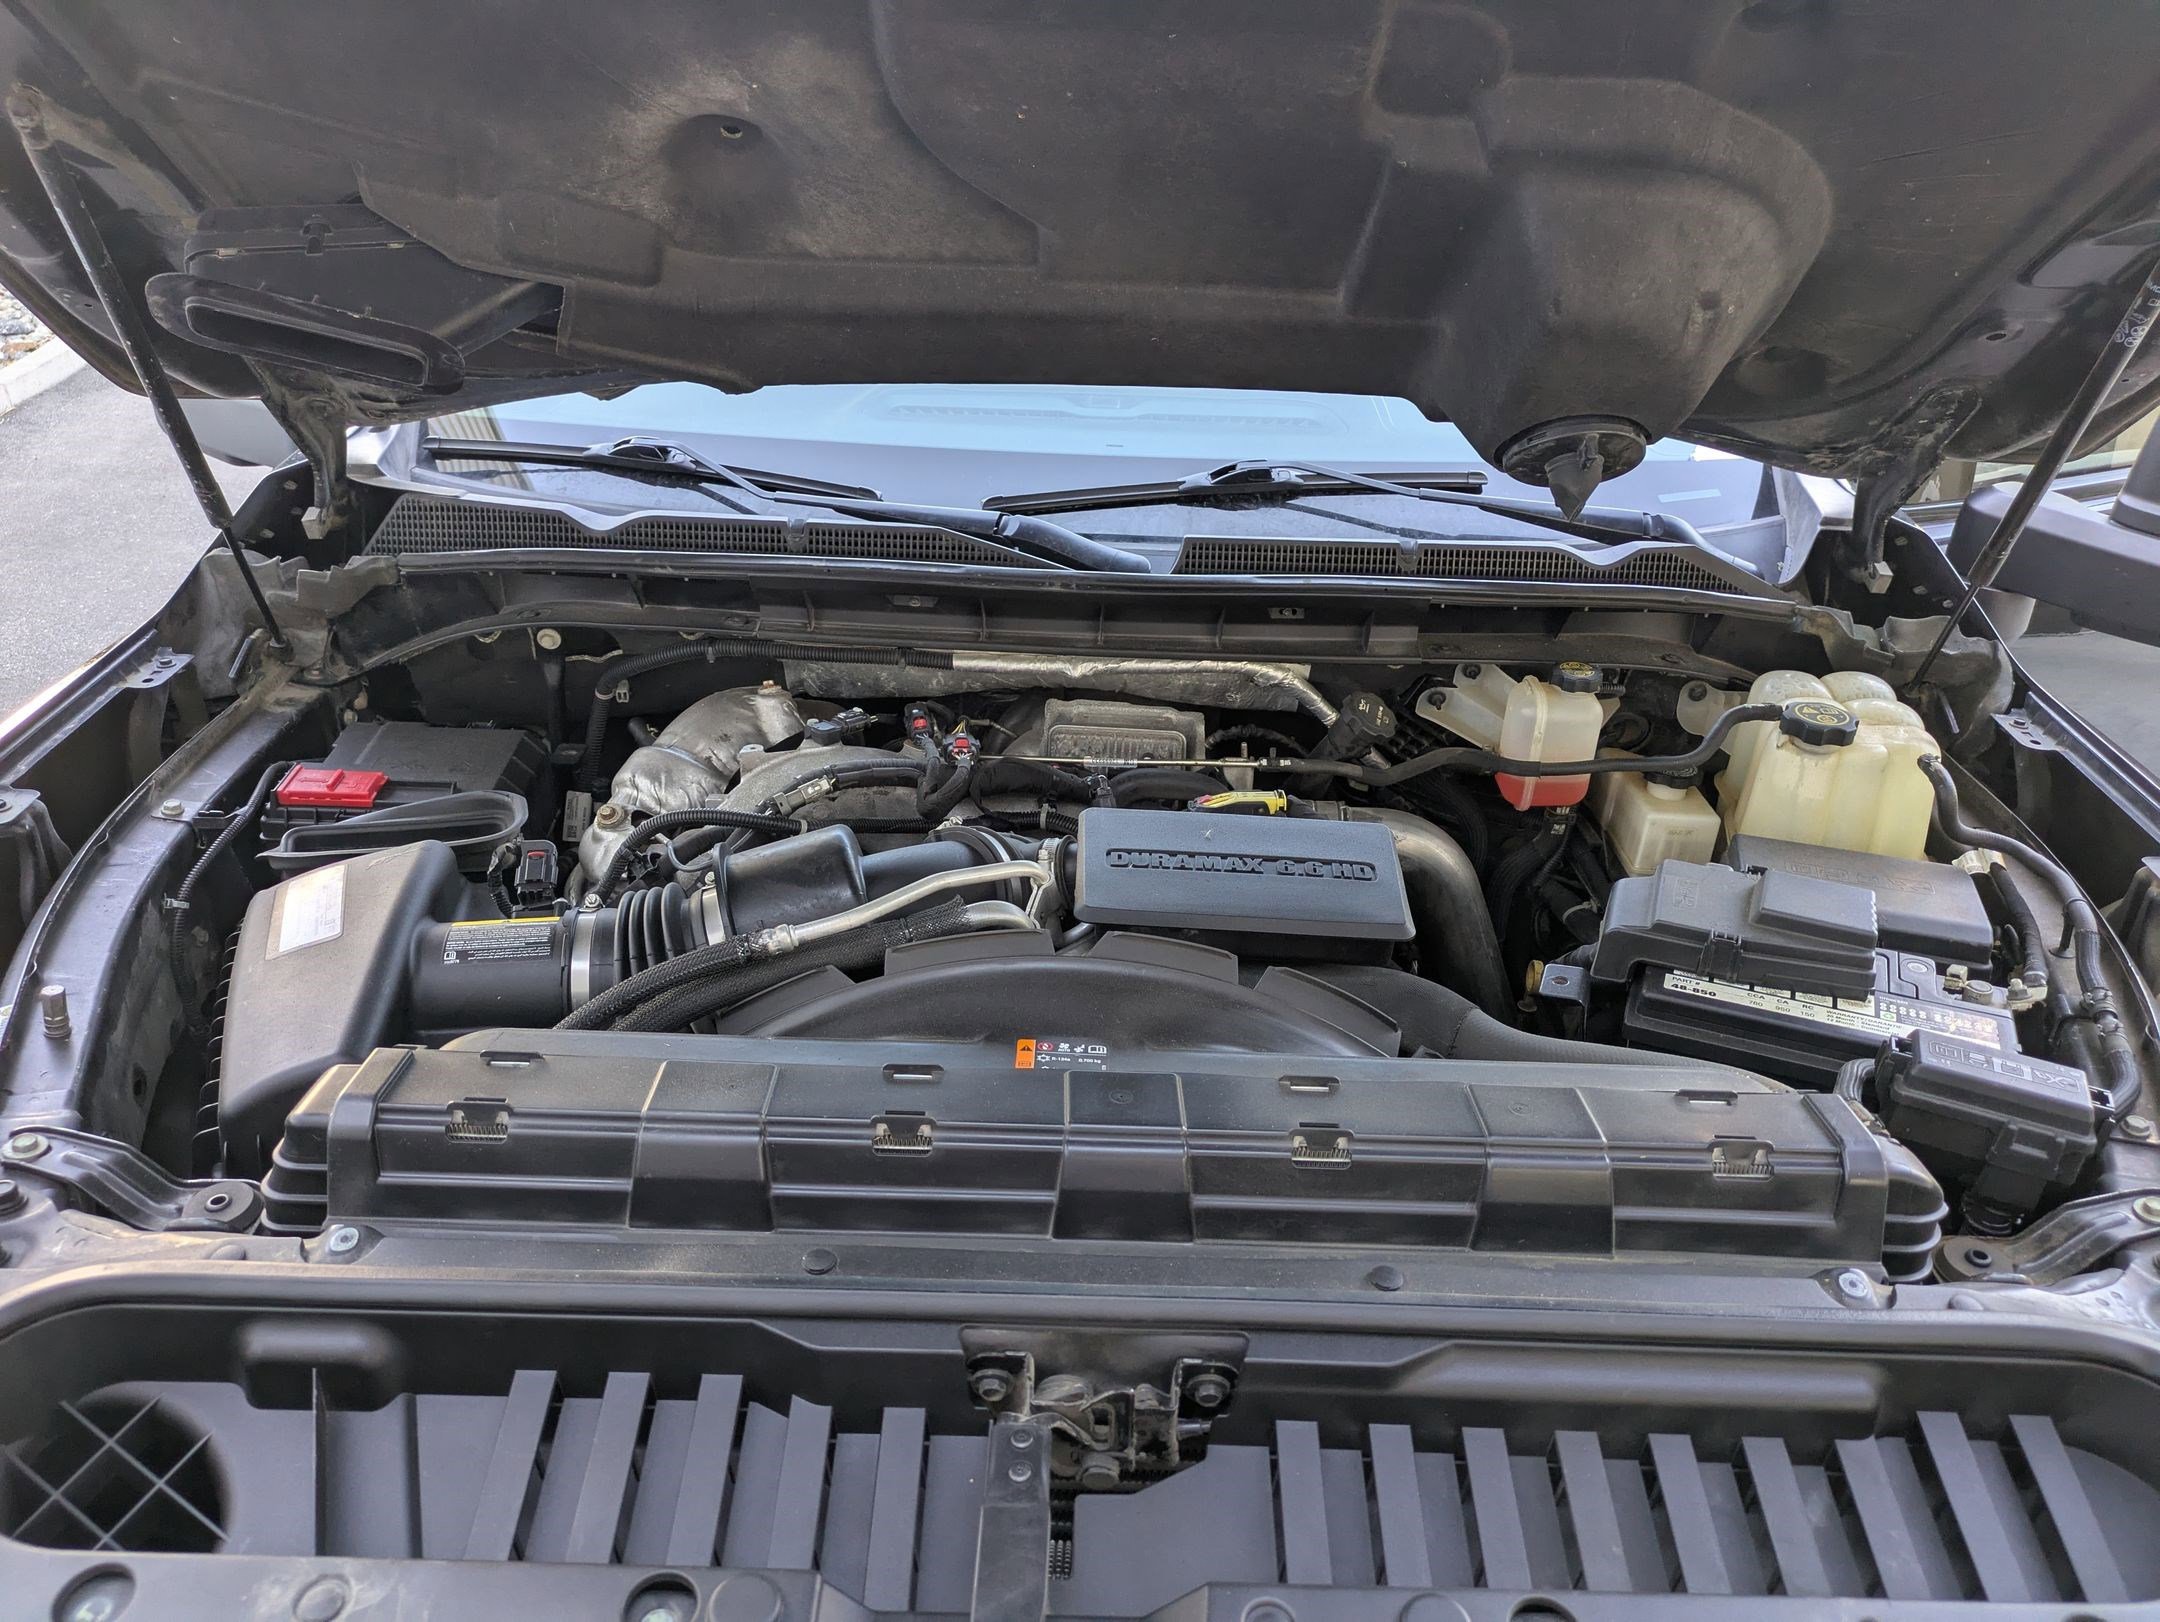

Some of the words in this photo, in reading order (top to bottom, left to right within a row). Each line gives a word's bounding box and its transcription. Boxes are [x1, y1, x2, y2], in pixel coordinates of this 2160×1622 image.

[1109, 851, 1265, 875] DURAMAX
[1276, 859, 1325, 878] 6.6
[1330, 862, 1373, 882] HD
[1672, 976, 1694, 984] PART
[1671, 983, 1717, 997] 48-850
[1747, 992, 1765, 1000] CCA
